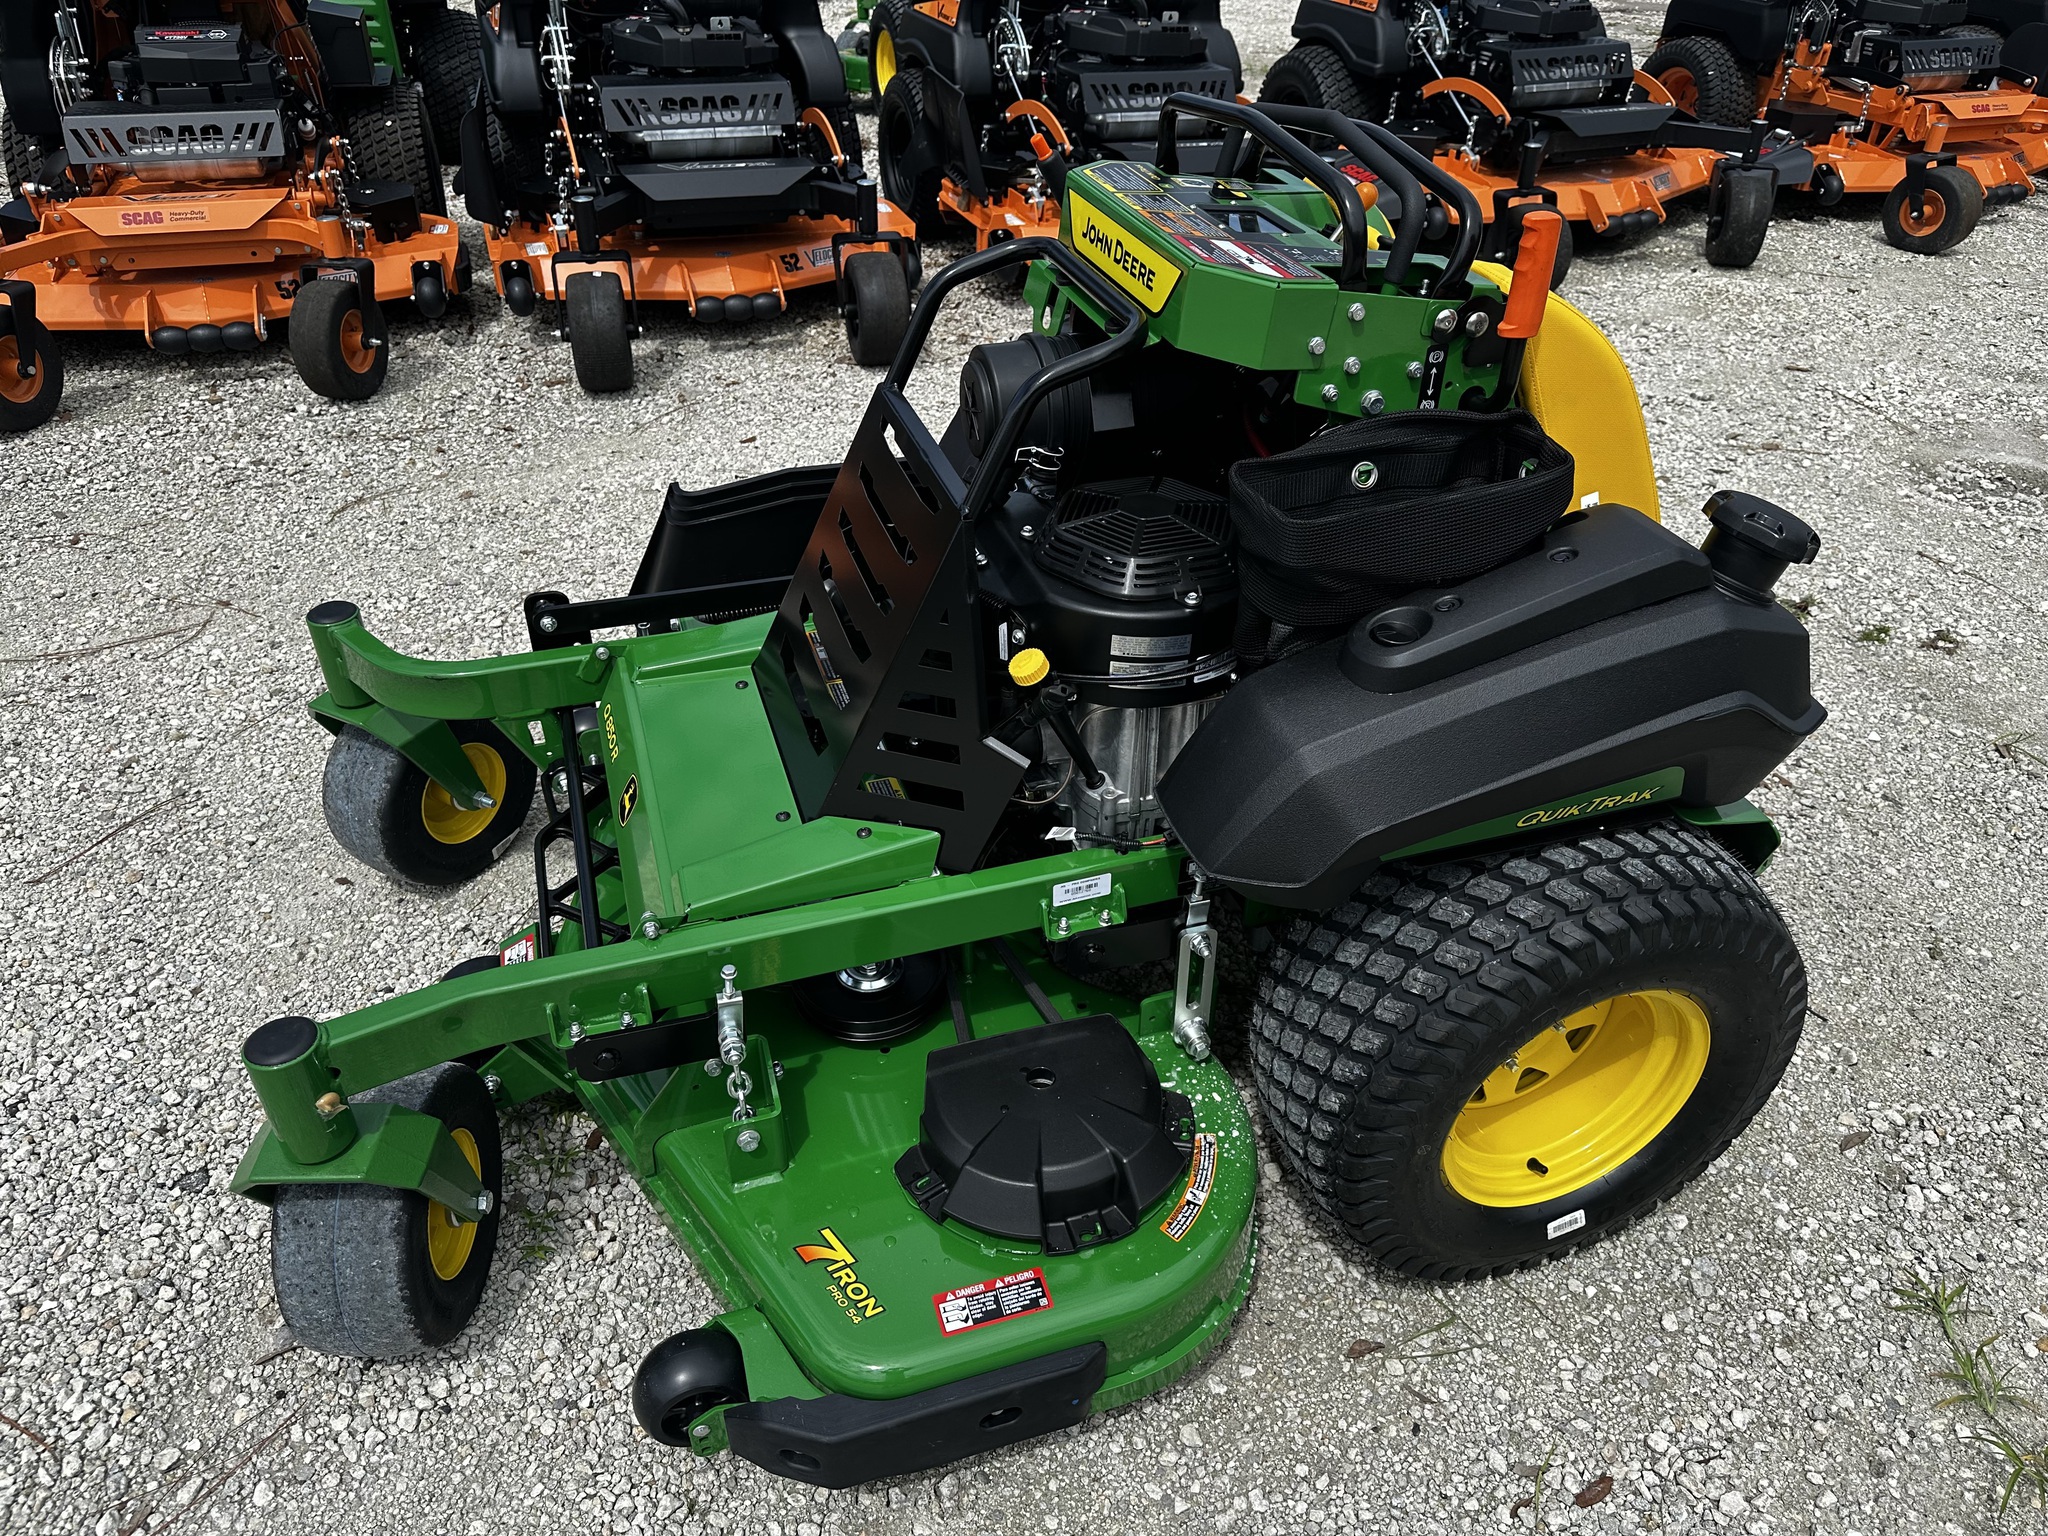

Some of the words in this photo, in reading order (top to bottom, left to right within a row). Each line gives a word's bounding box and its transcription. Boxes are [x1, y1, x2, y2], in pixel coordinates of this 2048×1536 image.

[1547, 54, 1600, 79] SCAG
[1929, 46, 1973, 69] SCAG
[660, 94, 742, 125] SCAG
[1971, 103, 1991, 113] SCAG
[125, 123, 226, 156] SCAG
[121, 211, 164, 226] SCAG
[169, 209, 205, 218] Heavy-Duty
[779, 253, 804, 273] 52
[1081, 216, 1112, 258] JOHN
[1113, 238, 1156, 292] DEERE
[274, 279, 301, 300] 52
[603, 703, 619, 763] Q850R
[1003, 1270, 1035, 1286] PELIGRO
[955, 1283, 985, 1298] DANGER
[825, 1284, 849, 1307] PRO
[845, 1308, 863, 1325] 54
